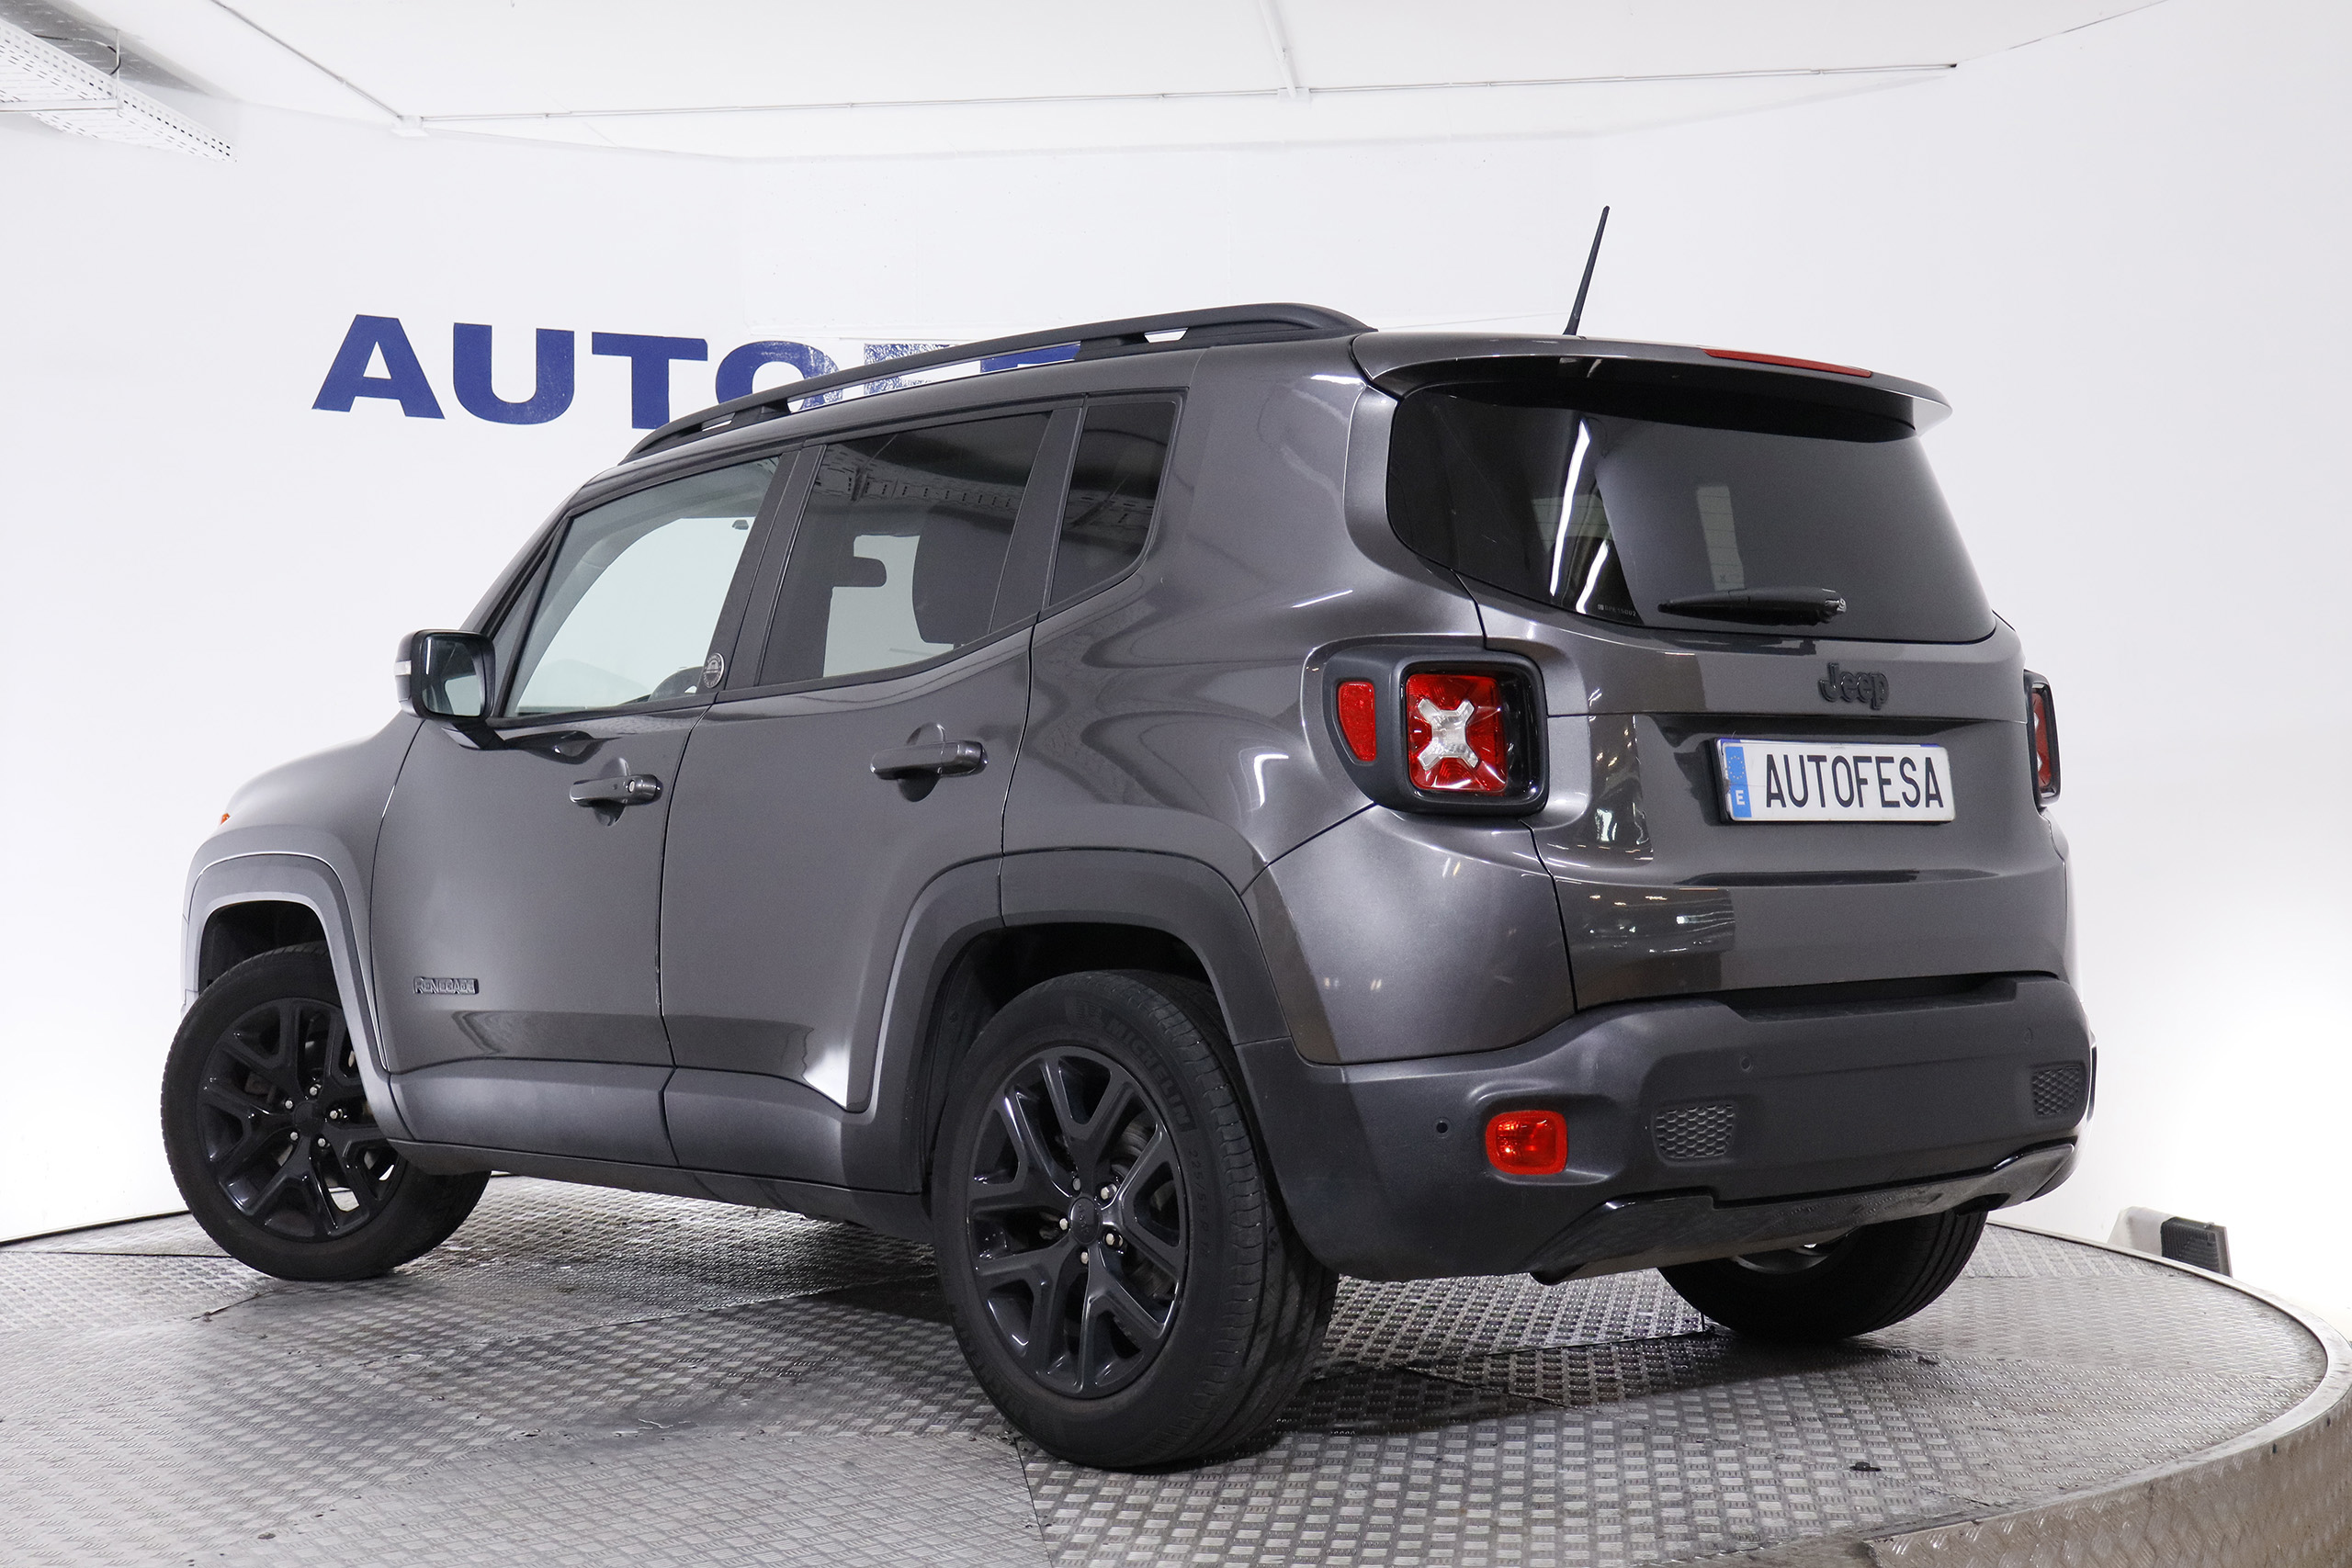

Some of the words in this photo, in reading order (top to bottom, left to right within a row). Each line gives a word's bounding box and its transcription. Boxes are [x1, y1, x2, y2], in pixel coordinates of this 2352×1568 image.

[1818, 662, 1889, 710] Jeep
[1735, 790, 1746, 806] E
[1766, 753, 1944, 808] AUTOFESA
[413, 976, 479, 994] RENEGADE
[1105, 1017, 1193, 1127] MICHELIN
